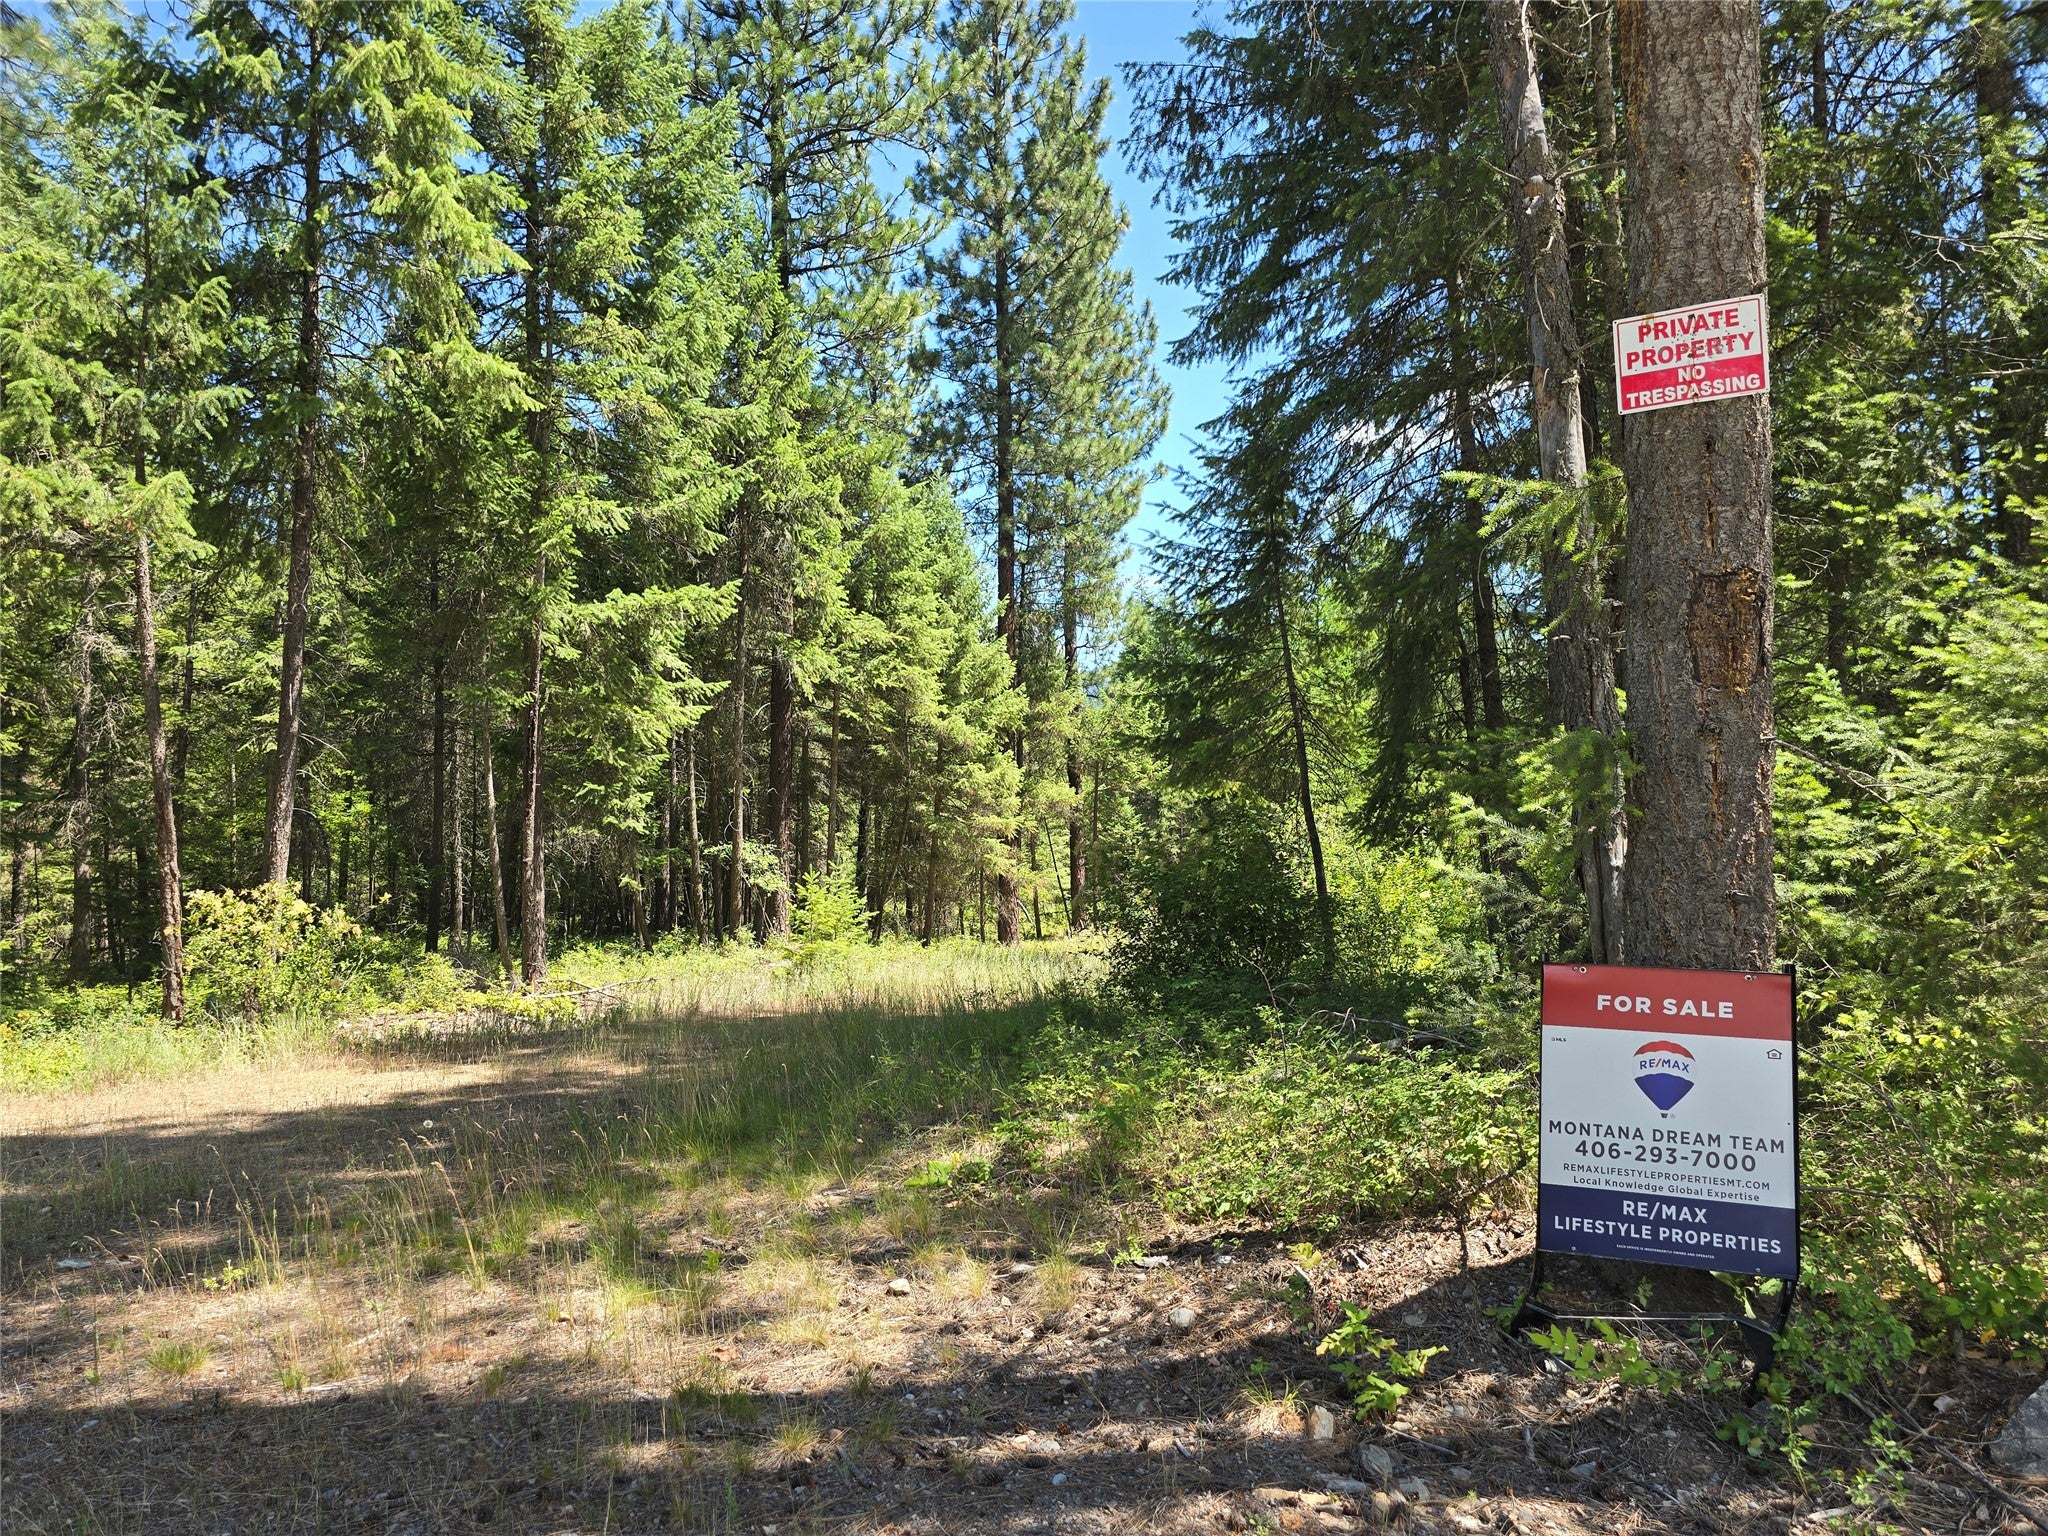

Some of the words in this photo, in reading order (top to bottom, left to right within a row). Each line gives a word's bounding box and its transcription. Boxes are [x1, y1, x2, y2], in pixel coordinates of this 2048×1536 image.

[1638, 308, 1739, 343] PRIVATE
[1626, 331, 1755, 370] PROPERTY
[1677, 365, 1706, 383] NO
[1626, 373, 1761, 407] TRESPASSING
[1597, 994, 1651, 1013] FOR
[1662, 999, 1734, 1019] SALE
[1639, 1058, 1690, 1074] RE/MAX
[1549, 1120, 1645, 1141] MONTANA
[1652, 1129, 1721, 1148] DREAM
[1729, 1135, 1785, 1154] TEAM
[1575, 1140, 1756, 1172] 406-293-7000
[1563, 1162, 1770, 1191] REMAXLIFESTYLEPROPERTIESMT.COM
[1573, 1175, 1601, 1186] Local
[1605, 1178, 1664, 1193] Knowledge
[1667, 1185, 1703, 1196] Global
[1707, 1188, 1760, 1202] Expertise
[1622, 1200, 1708, 1224] RE/MAX
[1554, 1215, 1652, 1240] LIFESTYLE
[1659, 1227, 1782, 1254] PROPERTIES
